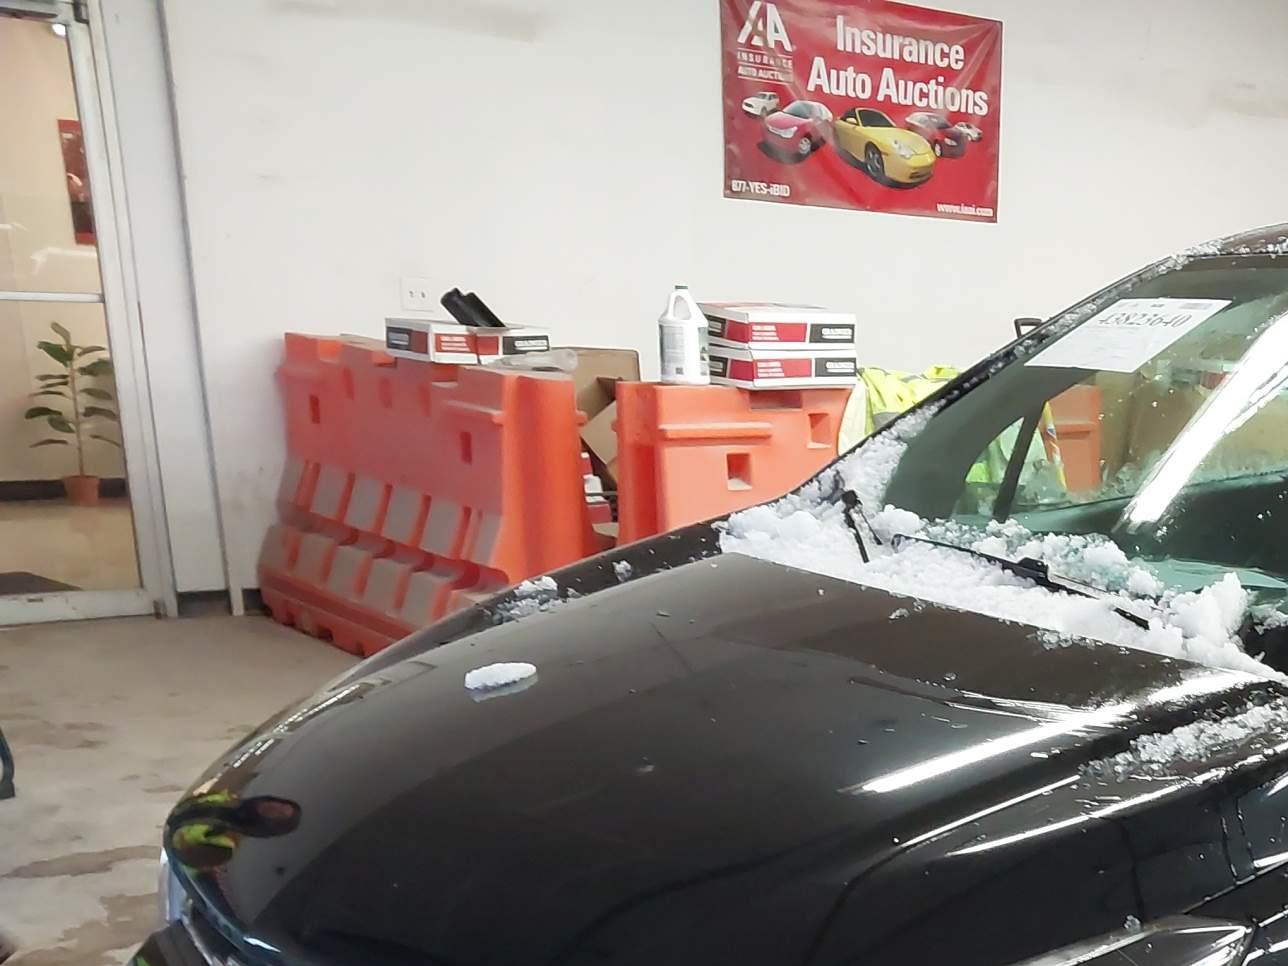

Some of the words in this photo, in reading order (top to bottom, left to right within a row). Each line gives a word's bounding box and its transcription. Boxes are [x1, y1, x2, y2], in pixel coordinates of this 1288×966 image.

[836, 14, 965, 71] Insurance
[807, 56, 872, 100] Auto
[877, 67, 989, 116] Auctions
